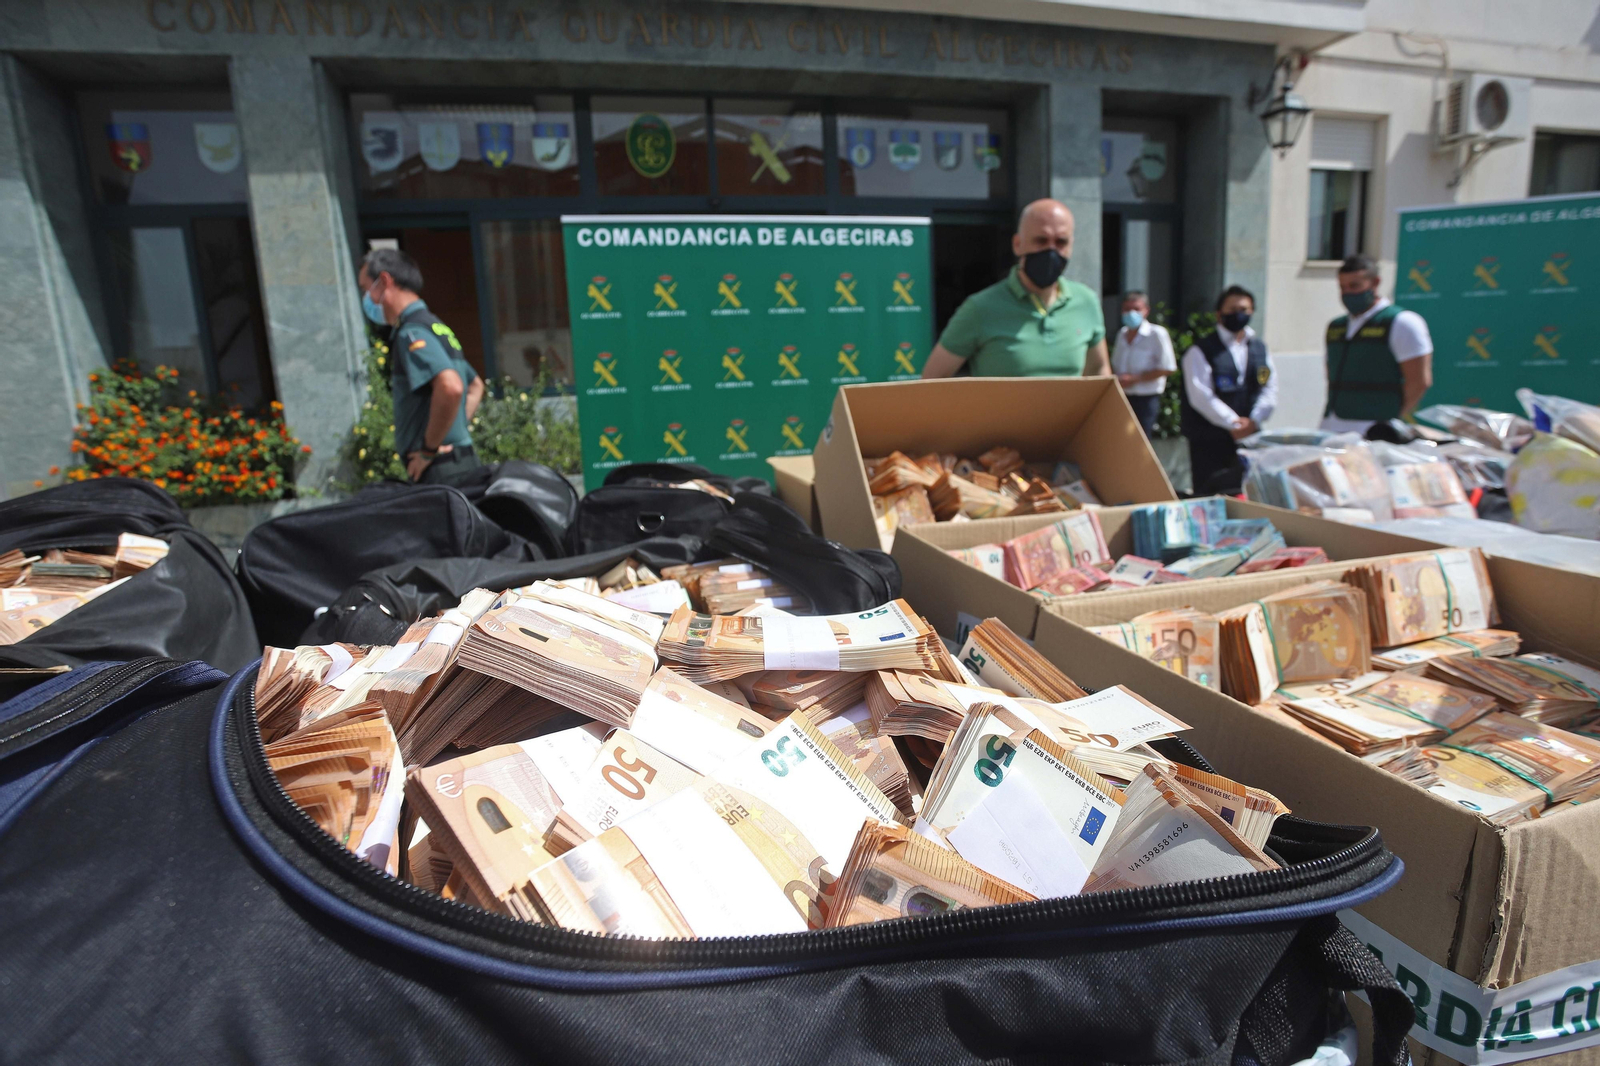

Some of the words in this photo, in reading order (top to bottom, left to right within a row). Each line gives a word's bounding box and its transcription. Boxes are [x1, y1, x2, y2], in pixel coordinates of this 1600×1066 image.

[147, 0, 534, 42] COMANDANCIA
[559, 8, 763, 51] GUARDIA
[787, 20, 900, 60] CIVIL
[922, 28, 1135, 74] ALGECIRAS
[1404, 211, 1528, 233] COMANDANCIA
[1530, 208, 1555, 223] DE
[576, 227, 753, 248] COMANDANCIA
[757, 227, 788, 247] DE
[791, 227, 915, 248] ALGECIRAS
[858, 606, 889, 620] 50
[1161, 628, 1197, 654] 50
[963, 647, 986, 676] 50
[1058, 726, 1119, 749] 50
[761, 735, 807, 777] 50
[974, 735, 1017, 787] 50
[601, 746, 658, 801] 50
[1033, 747, 1044, 758] EZB
[1044, 755, 1056, 765] EKP
[1065, 770, 1076, 781] ESB
[1075, 777, 1086, 789] EKB
[1095, 792, 1106, 804] EBC
[598, 805, 619, 831] EURO
[1128, 822, 1189, 872] VA1398581696
